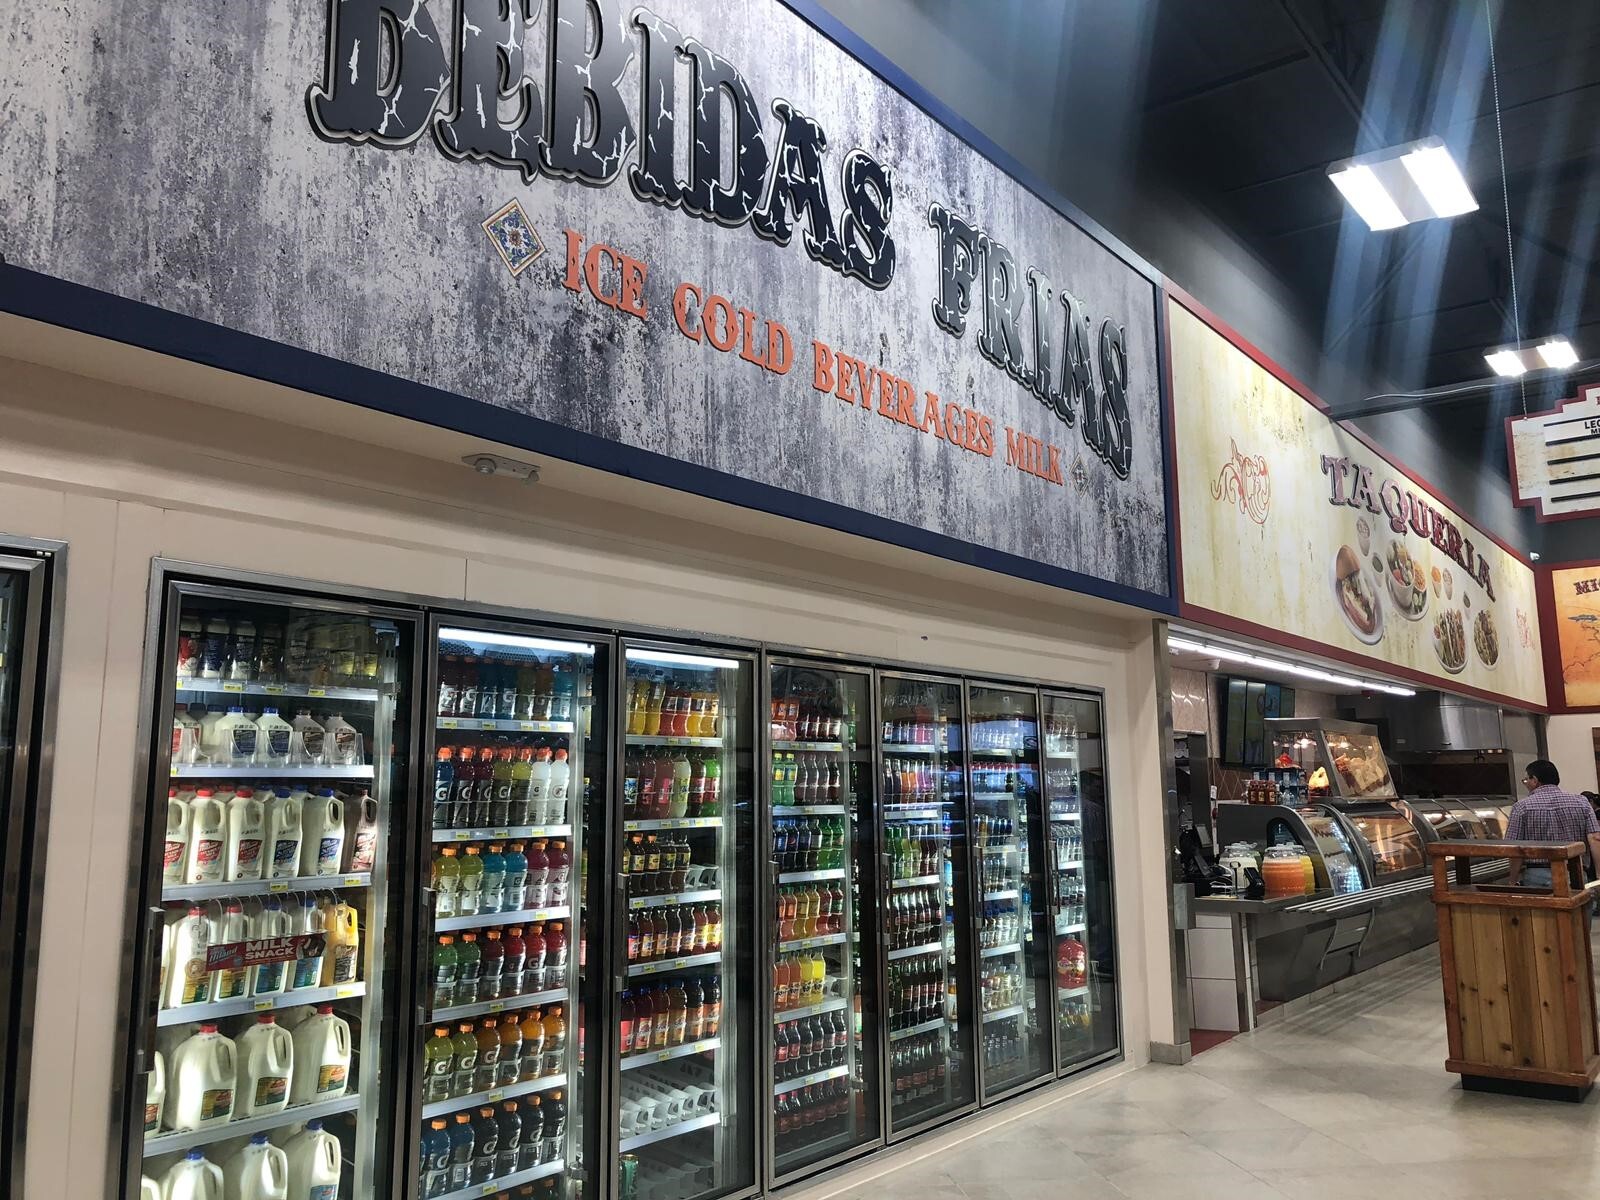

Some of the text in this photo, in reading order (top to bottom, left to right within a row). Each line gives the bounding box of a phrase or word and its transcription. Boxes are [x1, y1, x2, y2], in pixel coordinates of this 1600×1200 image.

[562, 227, 1063, 486] ICE COLD BEVERAGES MILK
[928, 201, 1133, 481] FRIAS
[1320, 454, 1497, 603] TAQUERIA
[1573, 578, 1600, 596] MI
[244, 946, 295, 960] SNACK
[245, 937, 295, 952] MILK
